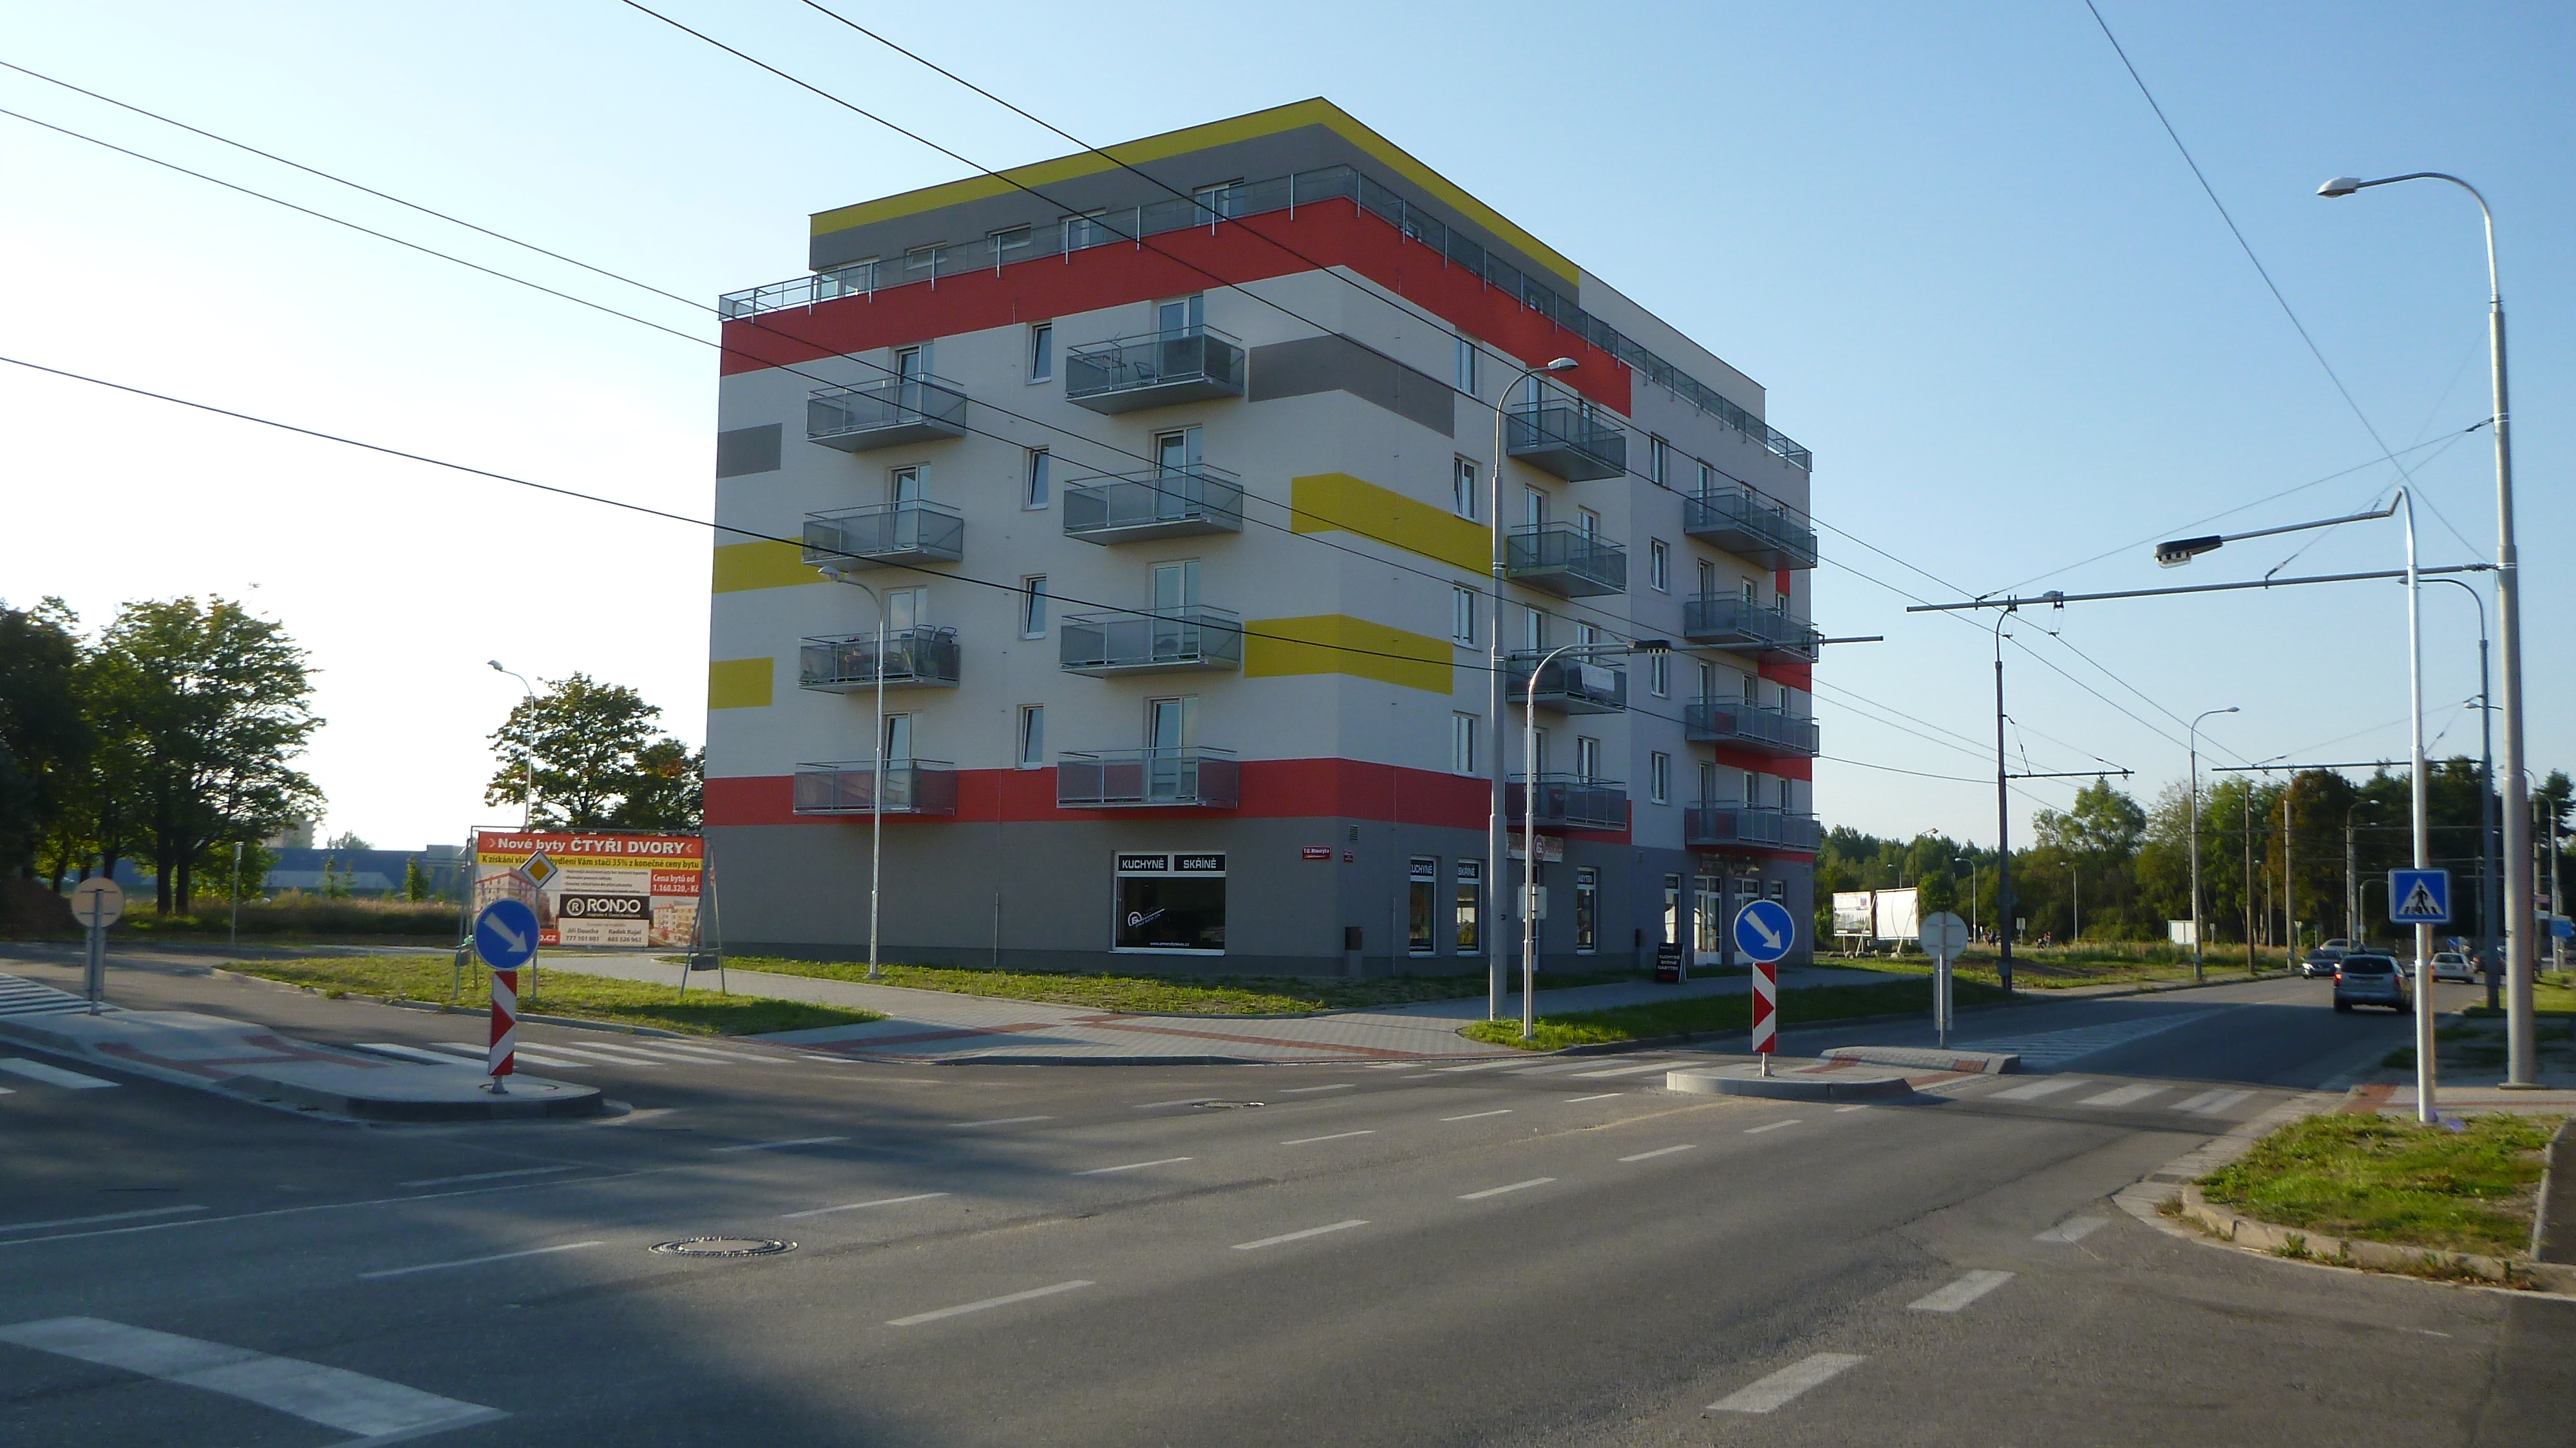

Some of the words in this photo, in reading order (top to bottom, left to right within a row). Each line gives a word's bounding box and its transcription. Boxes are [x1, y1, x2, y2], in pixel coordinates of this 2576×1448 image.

[498, 838, 533, 848] Nové
[536, 839, 566, 852] byty
[571, 837, 622, 852] ČTYŘI
[627, 841, 685, 854] DVORY
[482, 855, 488, 863] K
[488, 855, 513, 864] získání
[577, 857, 593, 865] Vám
[634, 859, 664, 868] konečné
[1122, 857, 1164, 869] KUCHYNĚ
[1183, 857, 1217, 869] SKŘÍNĚ
[1410, 863, 1433, 874] UCHYNĚ
[670, 874, 686, 883] bytů
[690, 884, 699, 893] Kč
[587, 897, 641, 913] RONDO
